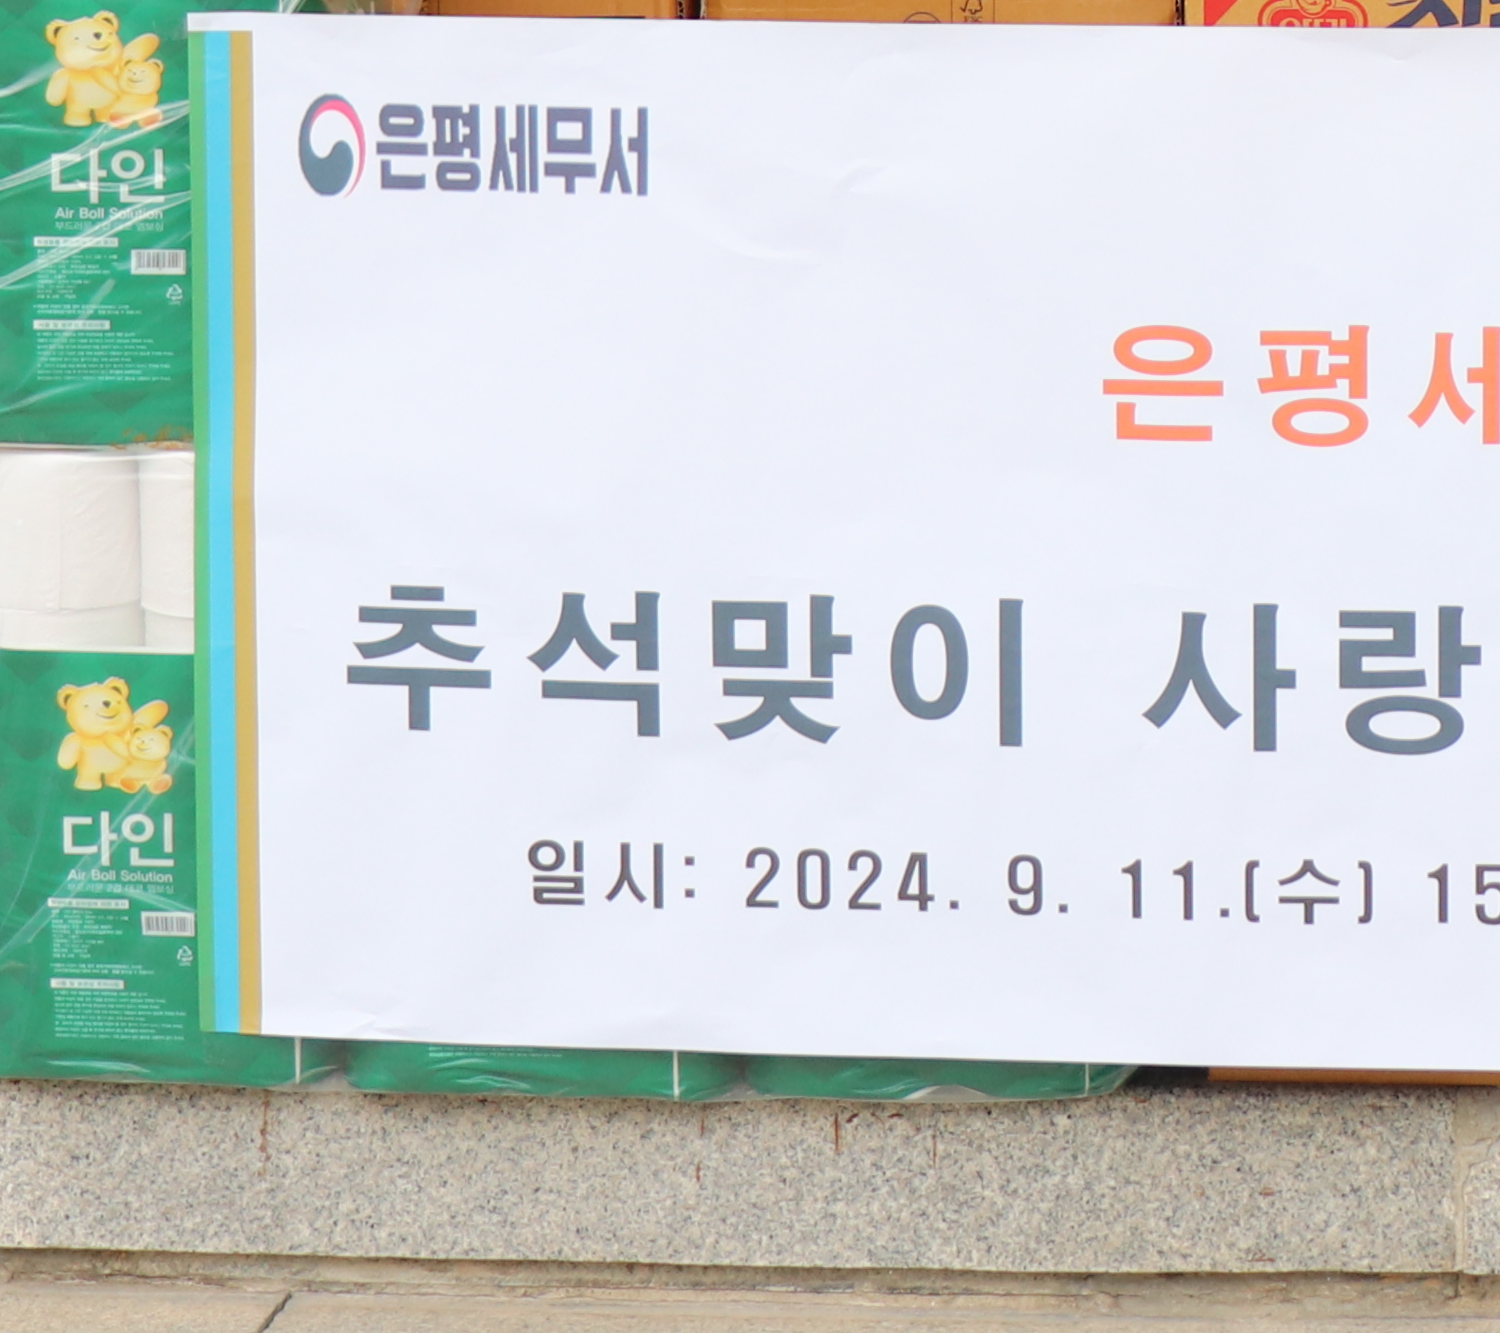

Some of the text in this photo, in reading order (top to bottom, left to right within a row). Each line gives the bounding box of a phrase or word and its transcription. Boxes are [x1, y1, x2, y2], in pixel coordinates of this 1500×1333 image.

[51, 148, 166, 204] 다인
[376, 104, 649, 195] 은평세무서
[346, 584, 1024, 748] 추석맞이
[62, 810, 175, 867] 다인
[527, 839, 696, 910] 일시:
[745, 846, 960, 912] 2024.
[1007, 854, 1069, 917] 9.
